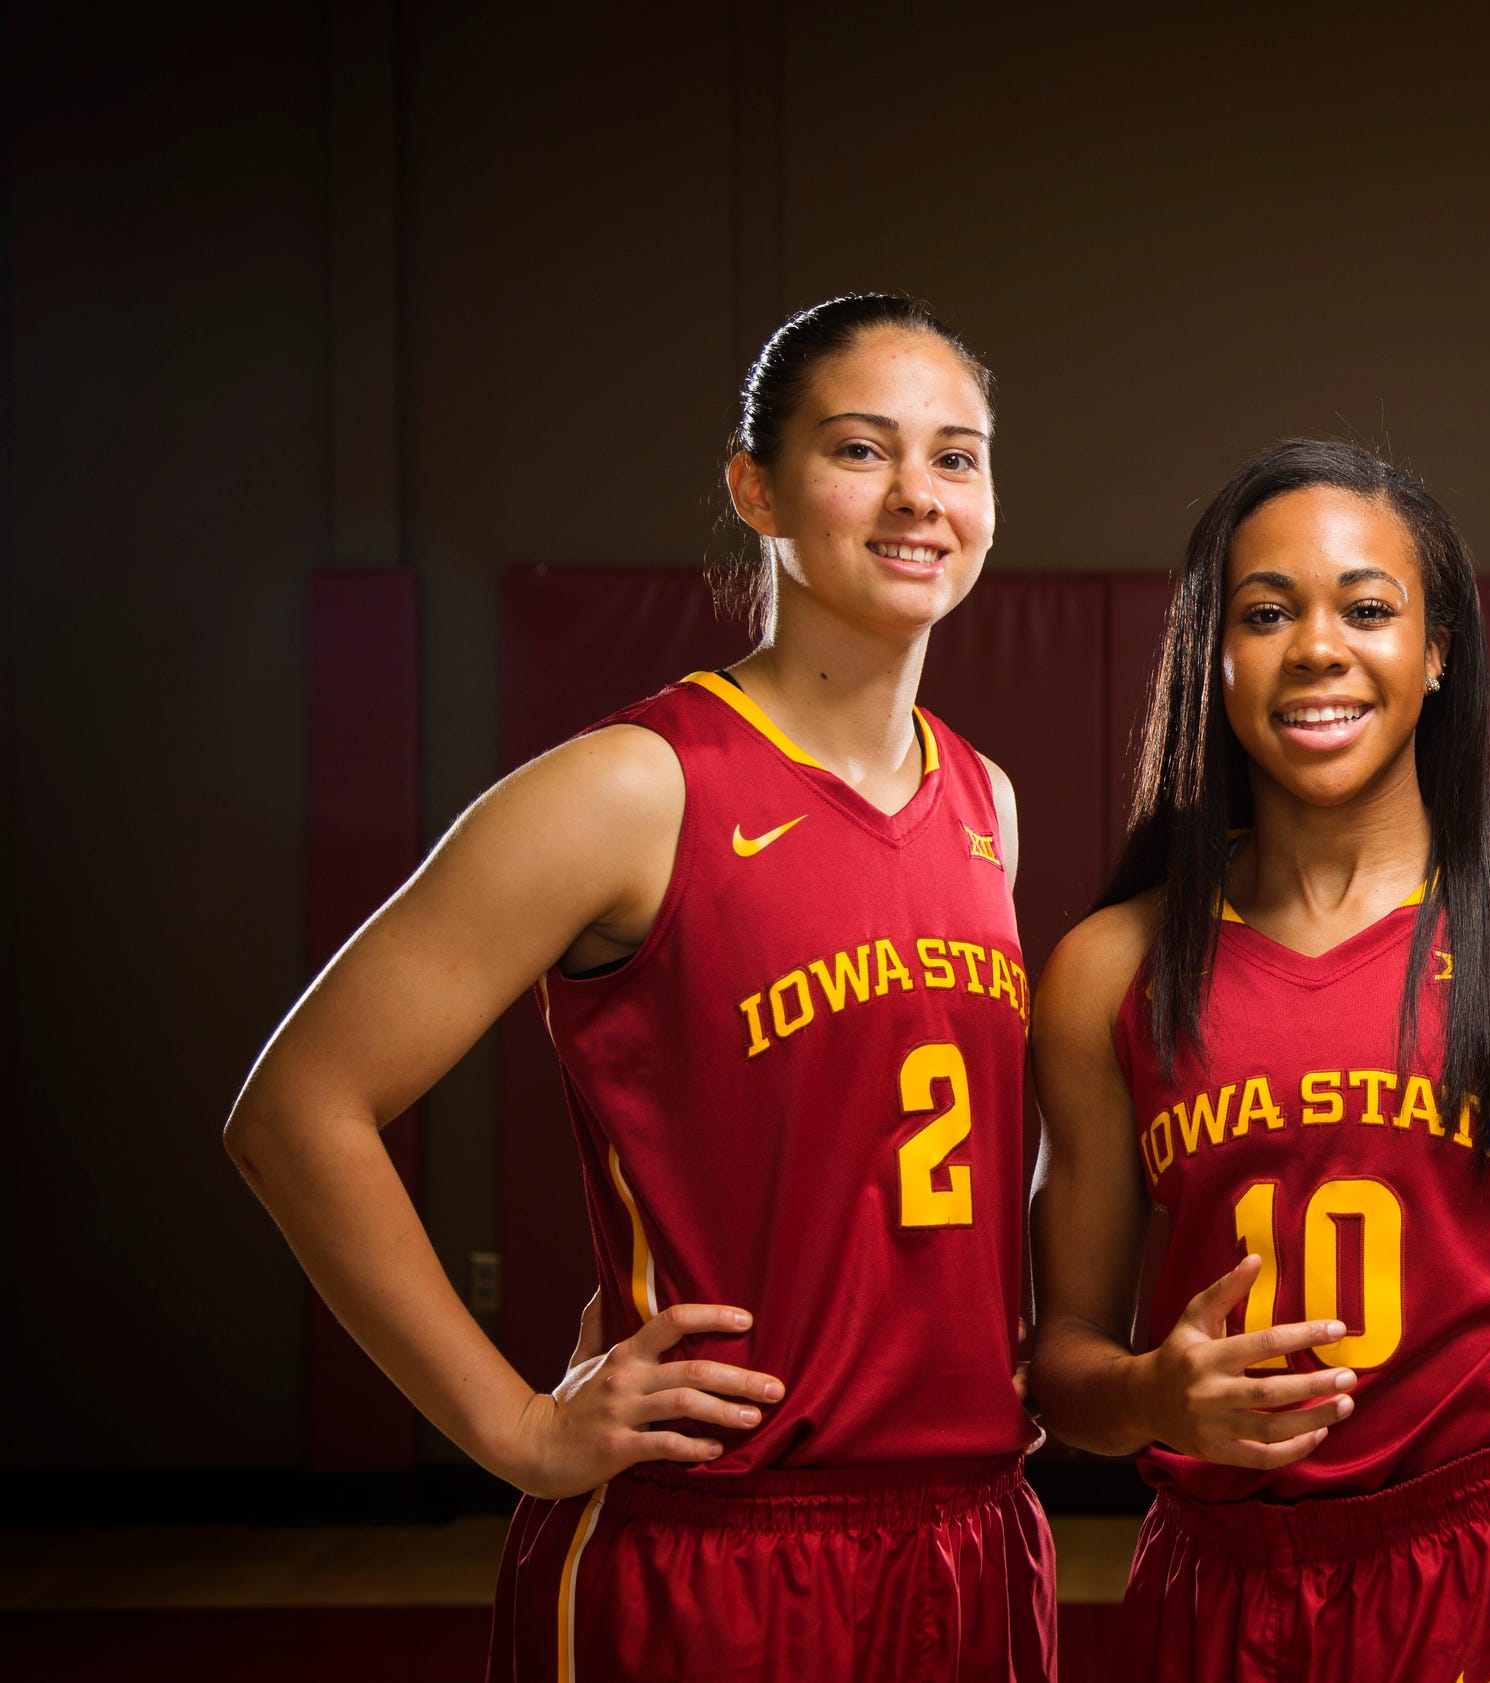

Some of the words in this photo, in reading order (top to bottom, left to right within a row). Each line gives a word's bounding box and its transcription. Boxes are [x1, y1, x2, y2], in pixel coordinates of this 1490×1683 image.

[739, 938, 914, 1058] IOWA
[916, 938, 1029, 1040] STAT
[899, 1042, 974, 1227] 2
[1141, 1076, 1285, 1187] IOWA
[1234, 1178, 1402, 1369] 10
